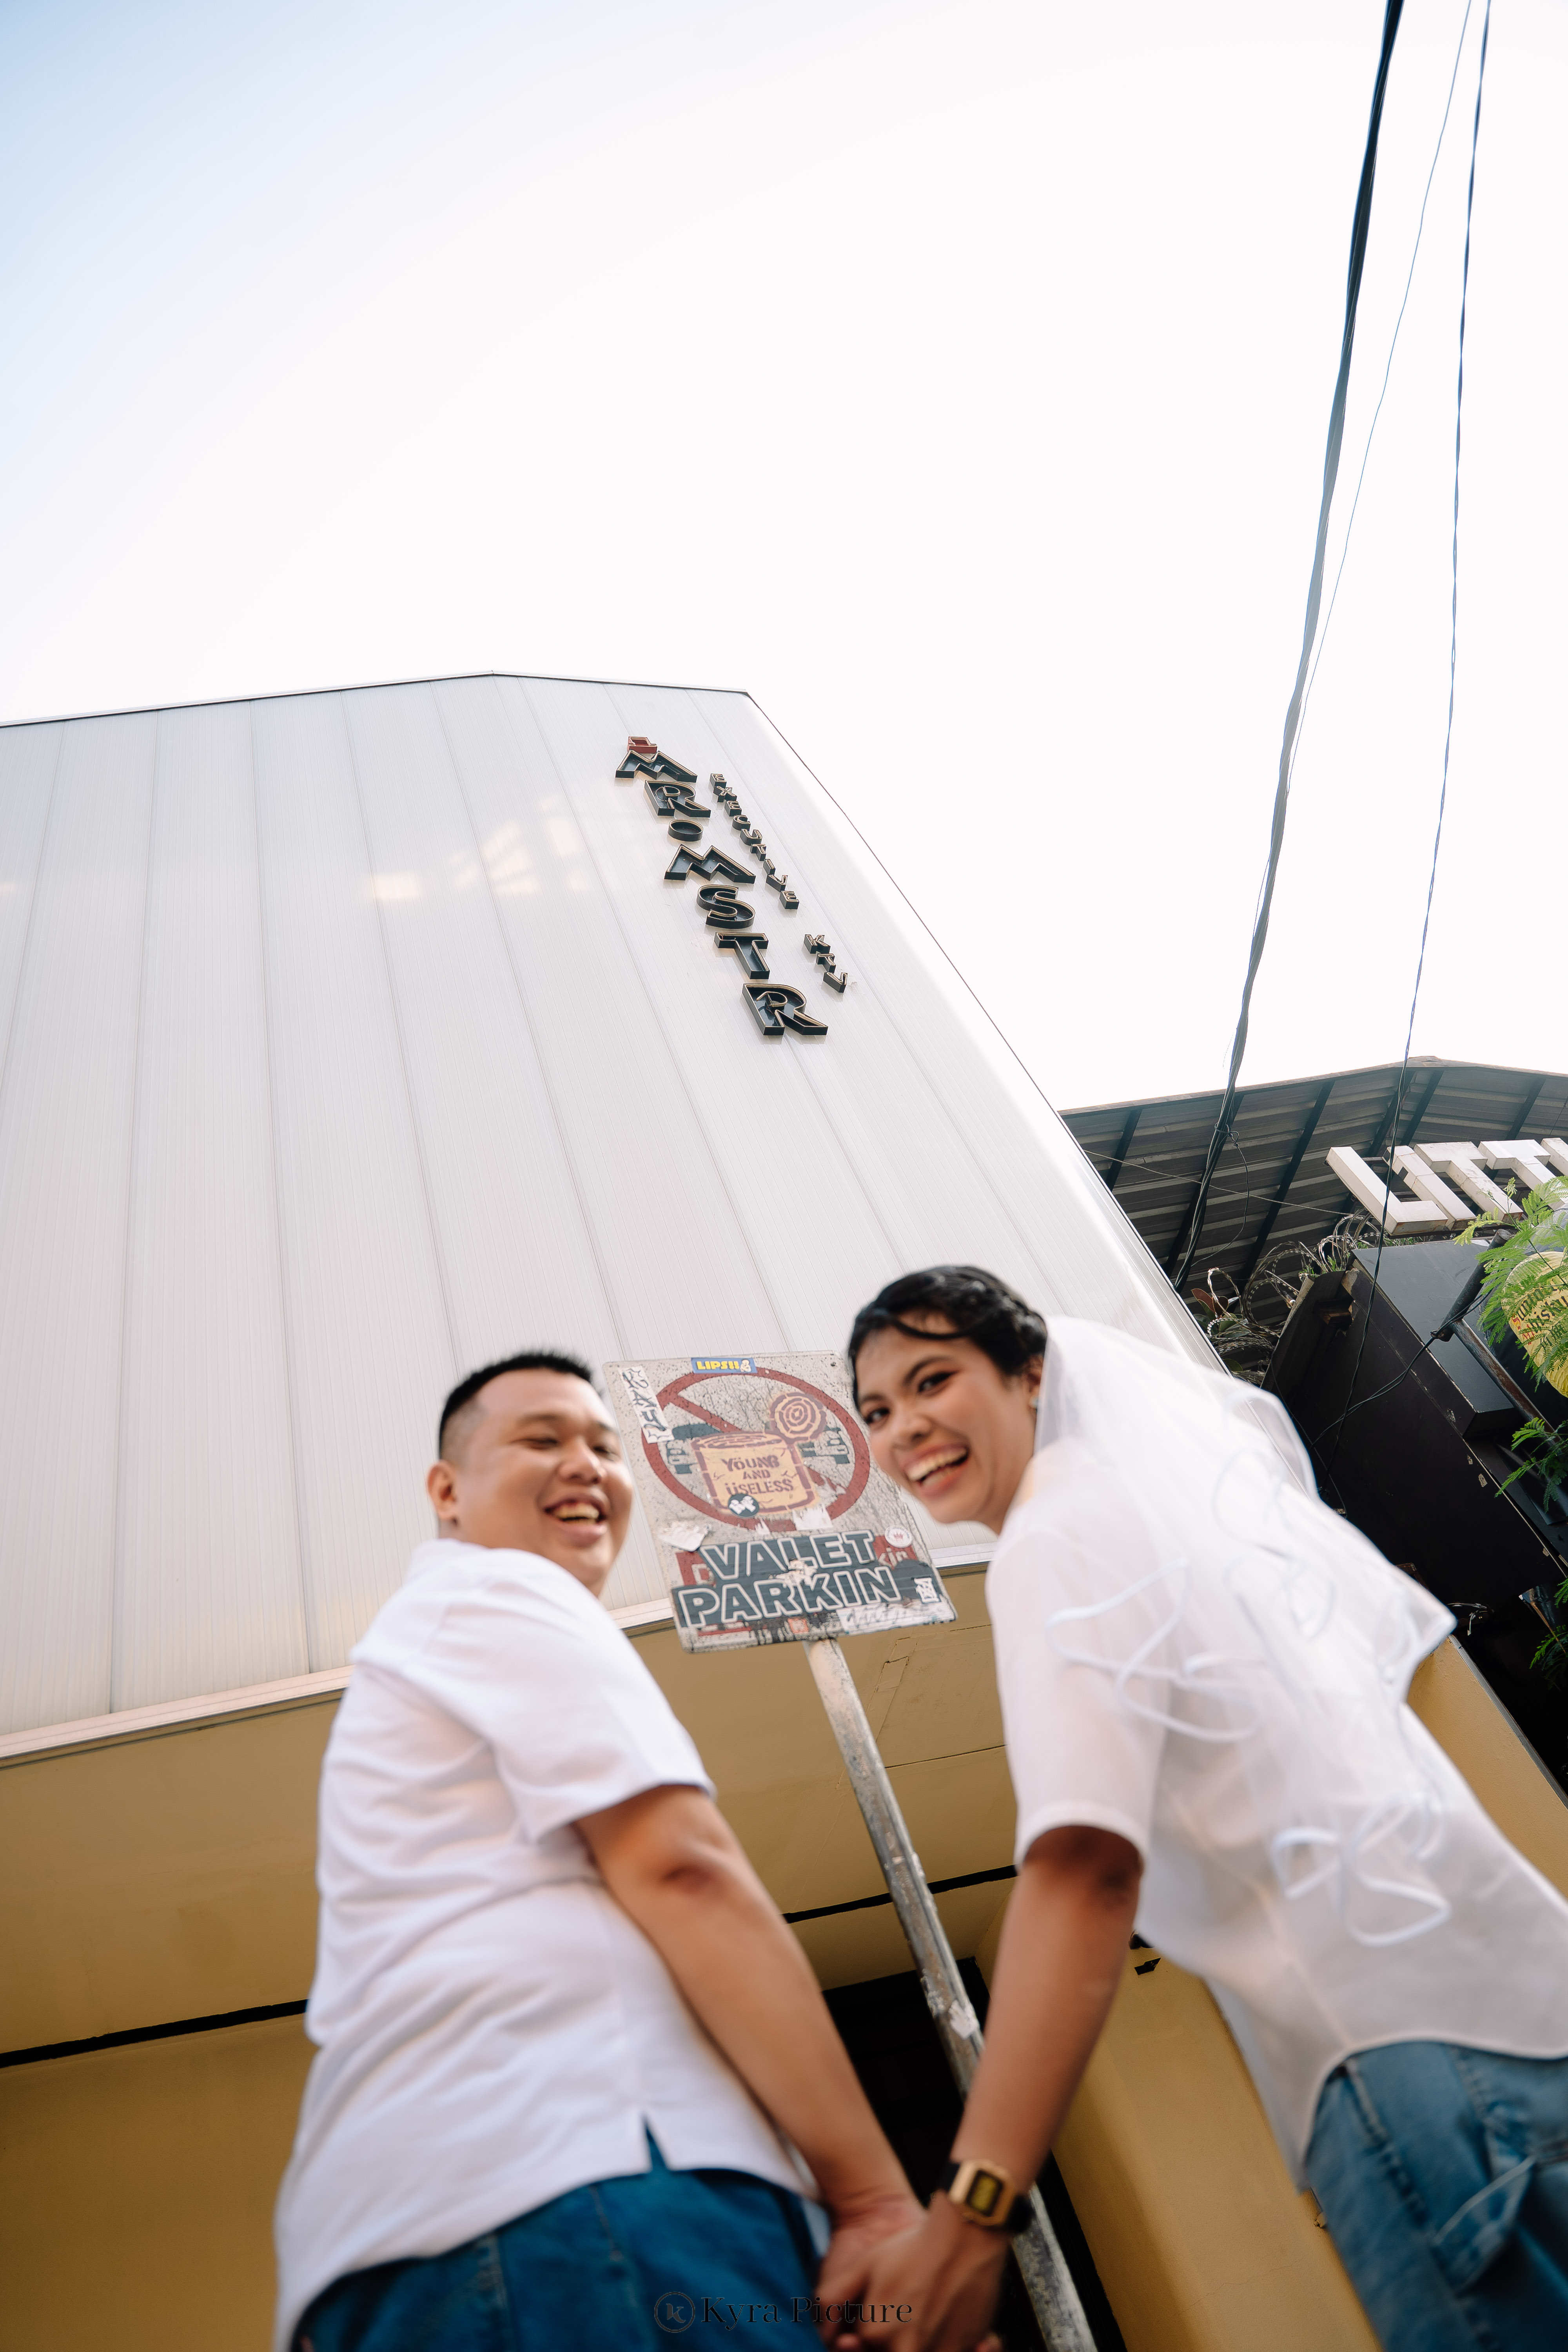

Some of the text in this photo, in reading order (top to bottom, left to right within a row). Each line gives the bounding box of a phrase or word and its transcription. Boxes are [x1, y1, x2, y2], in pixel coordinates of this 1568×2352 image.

[710, 773, 848, 993] EXECUTIVE KTV
[1326, 1137, 1568, 1236] LITT
[743, 1470, 771, 1479] AND
[699, 1529, 875, 1580] VALET
